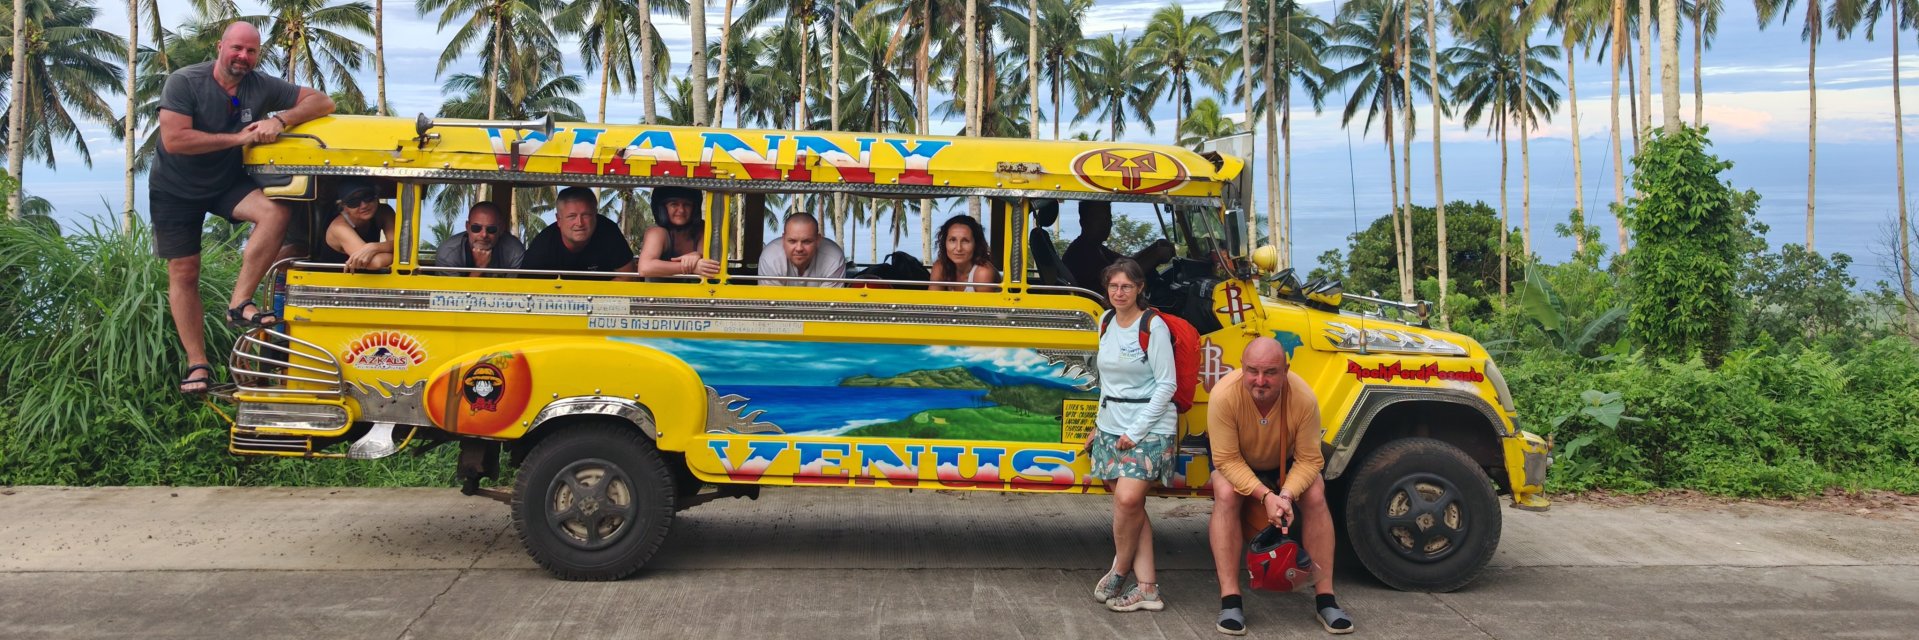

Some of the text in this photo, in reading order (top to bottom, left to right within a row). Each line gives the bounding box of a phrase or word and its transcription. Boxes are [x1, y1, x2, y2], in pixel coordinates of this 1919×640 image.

[488, 124, 952, 187] VIANNY
[651, 320, 711, 331] DRIVING?
[341, 330, 427, 365] CAMIGUIN
[358, 355, 407, 365] AZKALS
